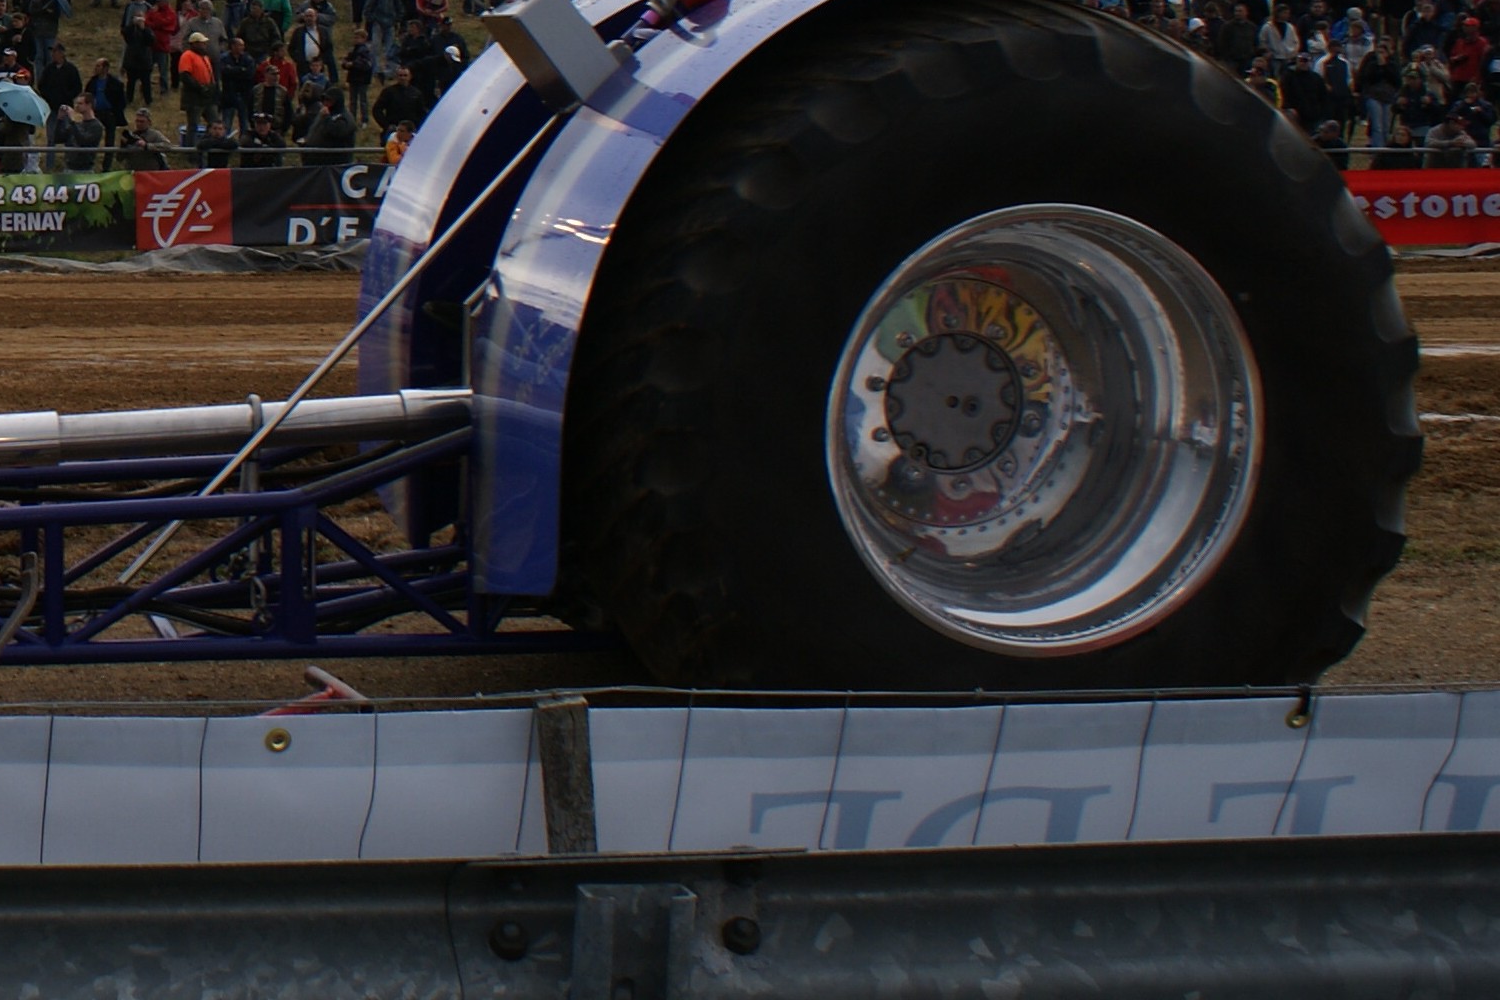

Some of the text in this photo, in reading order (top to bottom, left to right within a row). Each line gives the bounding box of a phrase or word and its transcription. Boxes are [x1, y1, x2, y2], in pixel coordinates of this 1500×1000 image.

[11, 186, 36, 204] 43
[43, 186, 68, 203] 44
[75, 184, 100, 202] 70
